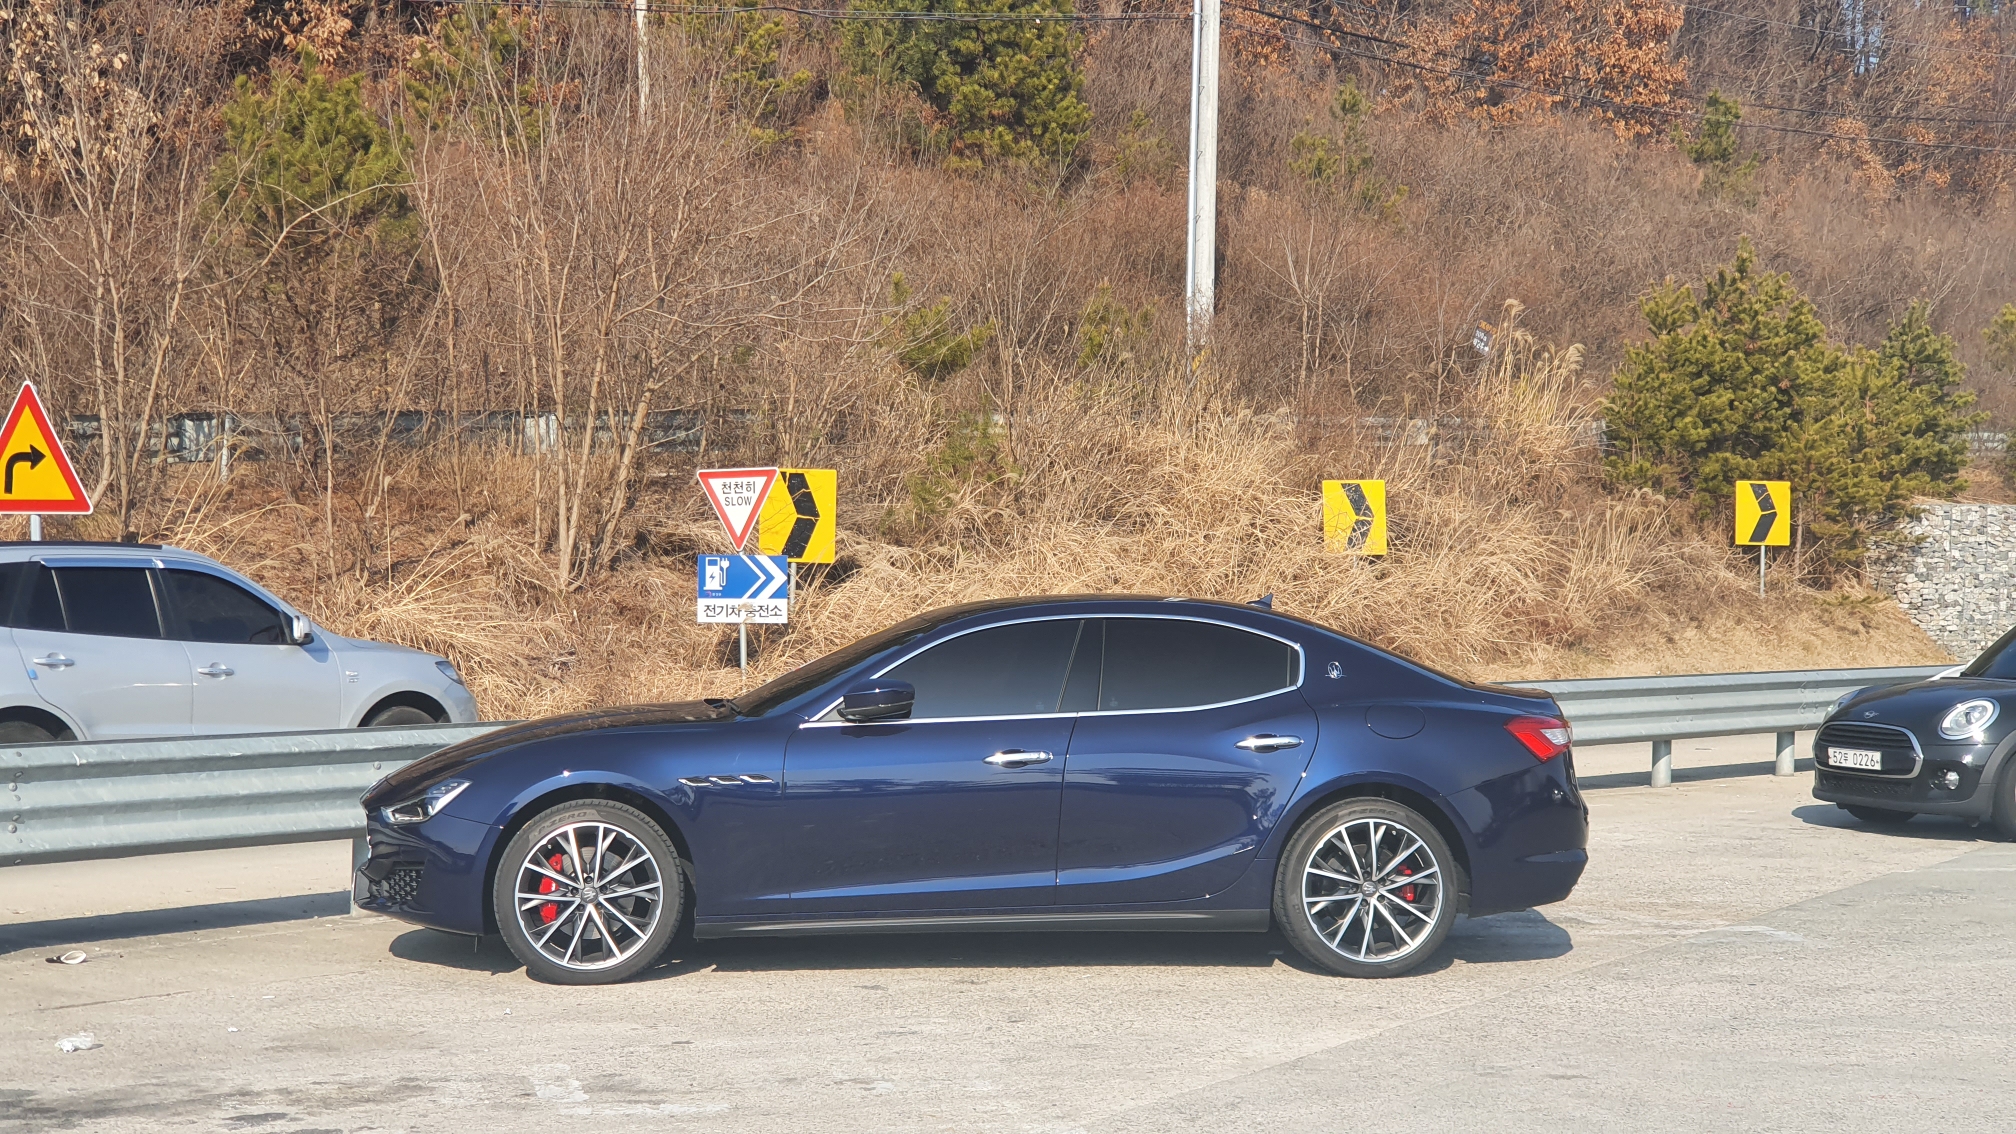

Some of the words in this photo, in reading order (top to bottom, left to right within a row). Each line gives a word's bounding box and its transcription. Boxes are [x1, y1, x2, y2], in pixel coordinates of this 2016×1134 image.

[721, 480, 756, 495] 천천히
[724, 496, 753, 507] SLOW
[703, 603, 743, 618] 전기차
[1852, 752, 1876, 768] 0226
